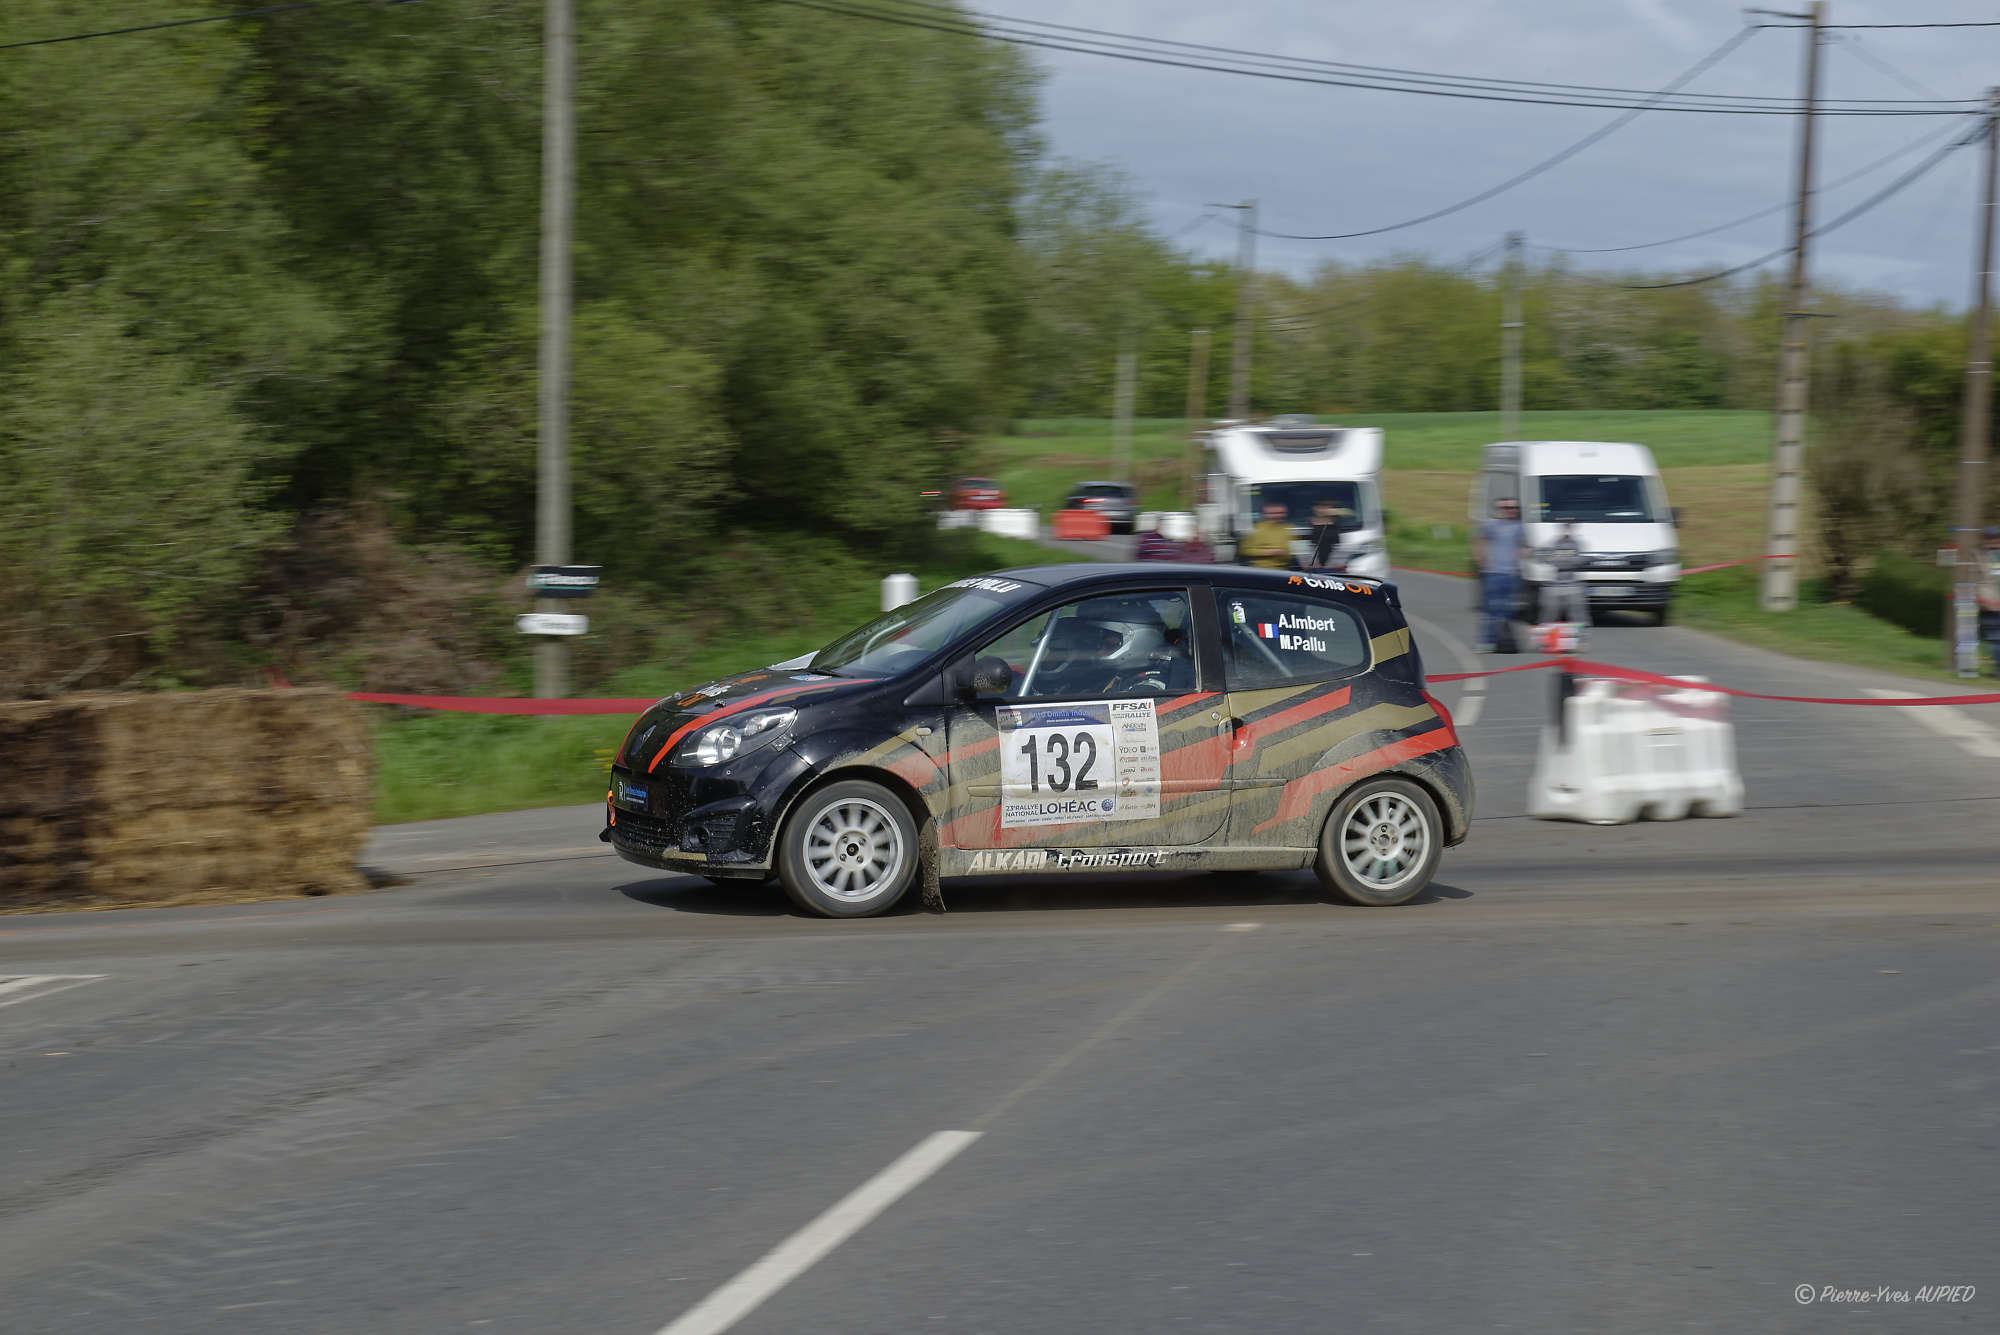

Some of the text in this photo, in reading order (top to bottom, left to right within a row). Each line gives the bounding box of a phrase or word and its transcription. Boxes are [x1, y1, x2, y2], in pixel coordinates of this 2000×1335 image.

[1278, 613, 1335, 631] A.Imbert
[1279, 634, 1326, 651] M.Pallu
[1112, 702, 1148, 711] FFSA
[1124, 711, 1151, 719] RALLYE
[1021, 731, 1099, 794] 132
[1039, 800, 1097, 815] LOHÉAC
